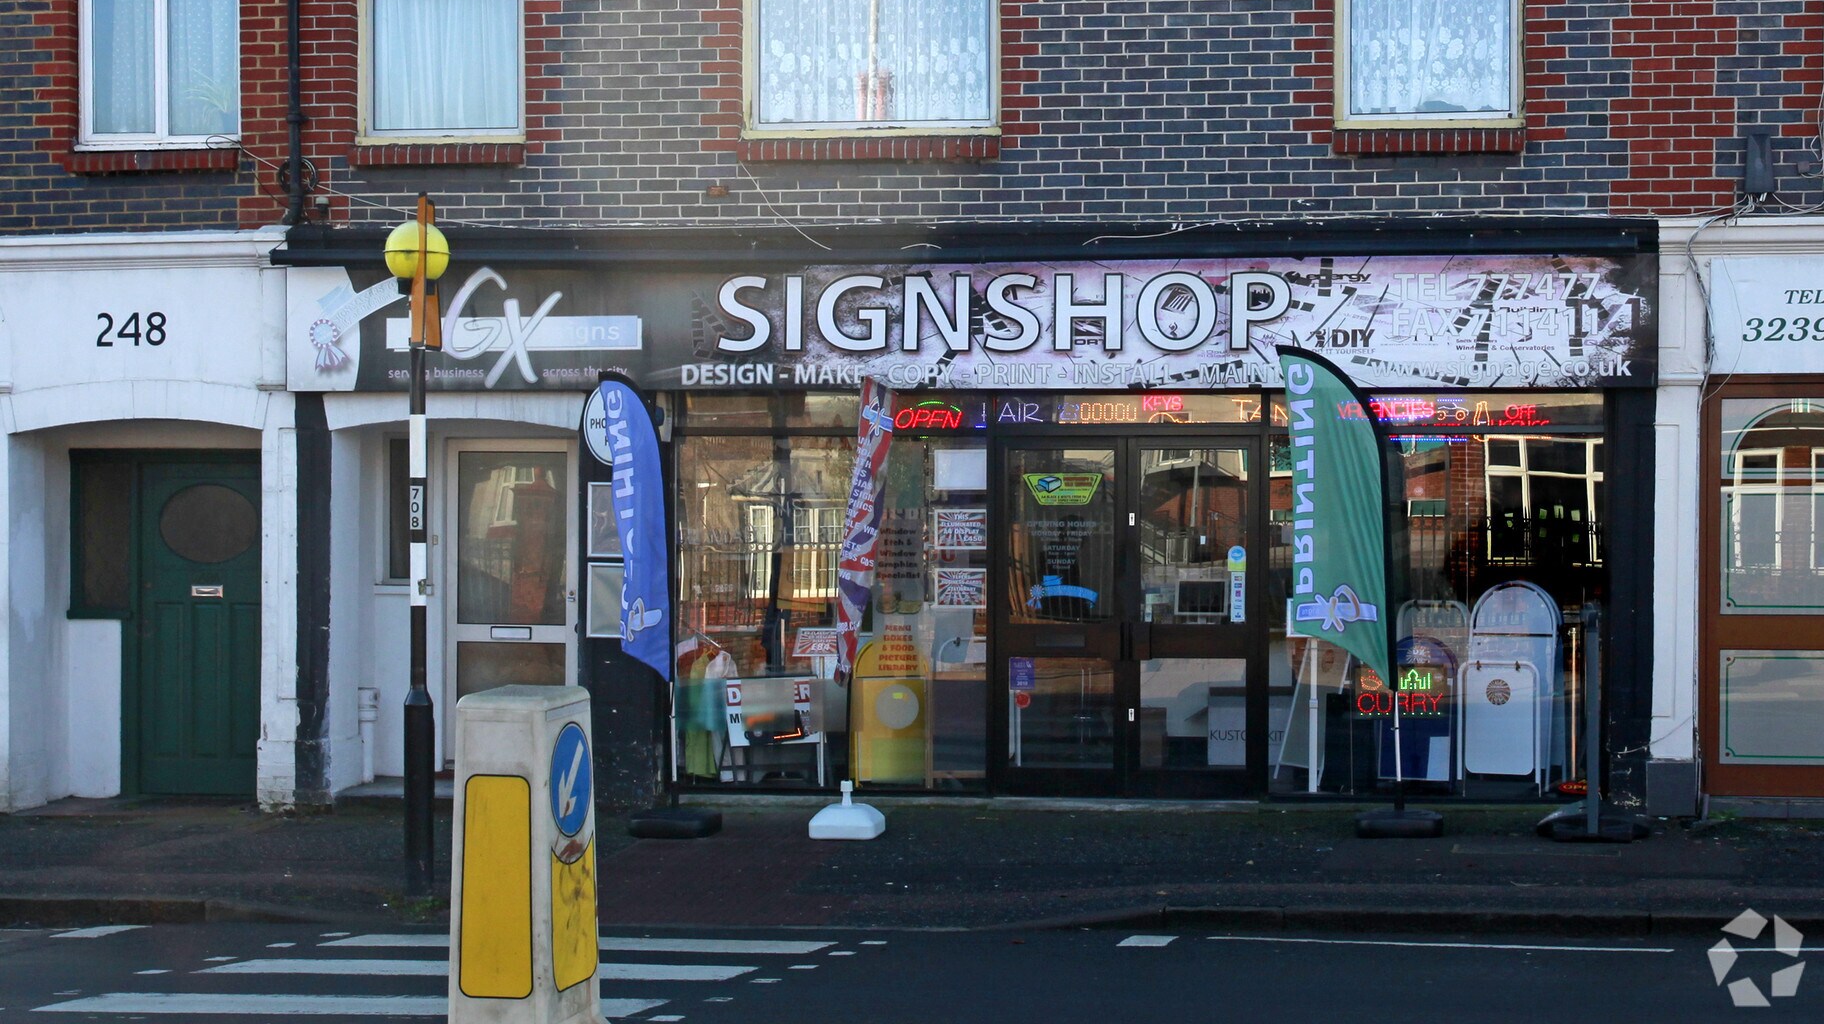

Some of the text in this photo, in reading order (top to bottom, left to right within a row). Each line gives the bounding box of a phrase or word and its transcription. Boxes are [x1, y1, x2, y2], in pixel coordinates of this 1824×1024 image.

[1394, 272, 1602, 301] TEL 777477
[717, 269, 1292, 353] SIGNSHOP
[1391, 308, 1462, 337] FAX
[1470, 308, 1599, 337] 711411
[96, 311, 167, 348] 248
[1331, 329, 1375, 347] DIY
[433, 366, 484, 379] business
[542, 367, 579, 377] across
[681, 363, 774, 386] DESIGN
[794, 363, 867, 385] MAKE
[887, 363, 956, 385] COPY
[977, 362, 1053, 385] PRINT
[1073, 362, 1177, 385] INSTALL
[1199, 362, 1285, 385] MAINT
[1371, 355, 1632, 383] www.signage.co.uk
[894, 408, 963, 429] OPEN
[1356, 692, 1444, 714] CURRY
[1210, 729, 1246, 742] KUSTO
